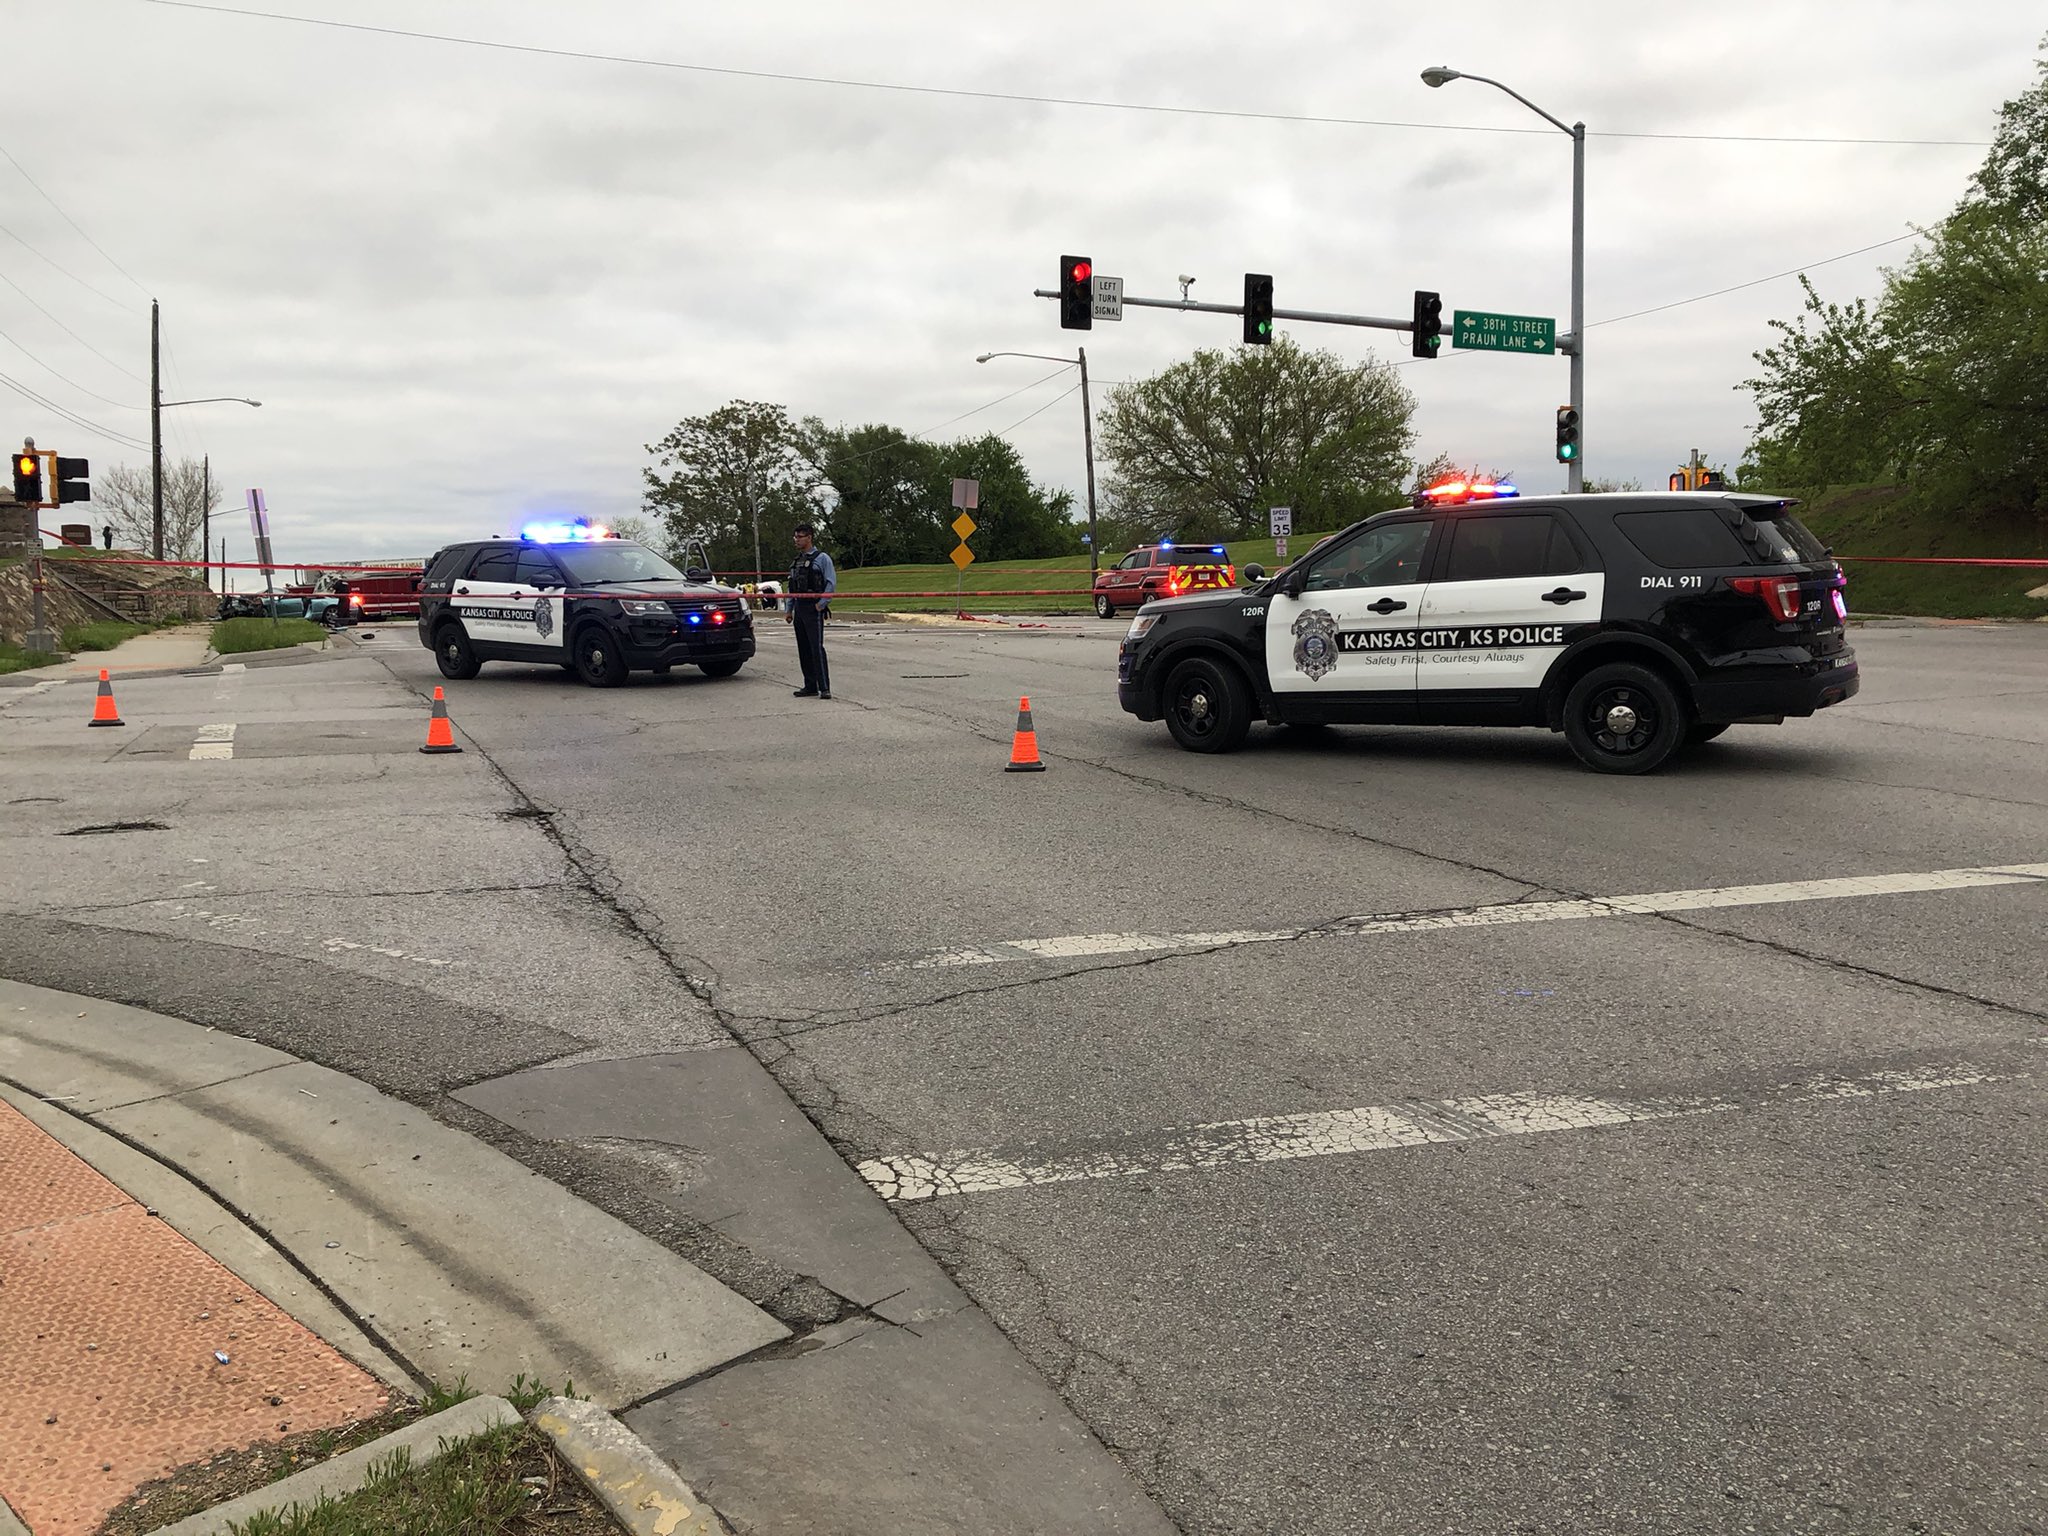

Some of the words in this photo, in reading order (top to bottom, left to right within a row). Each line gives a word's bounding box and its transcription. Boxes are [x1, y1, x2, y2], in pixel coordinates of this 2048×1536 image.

[1100, 281, 1116, 291] LEFT
[1098, 293, 1117, 303] TURN
[1095, 306, 1119, 316] SIGNAL
[1483, 318, 1506, 331] 38TH
[1513, 320, 1548, 334] STREET
[1462, 332, 1497, 346] PRAUN
[1503, 335, 1527, 348] LANE
[1273, 524, 1290, 536] 35
[1640, 576, 1674, 588] DIAL
[1680, 576, 1702, 588] 911
[461, 608, 486, 617] KANSAS
[503, 610, 511, 618] KS
[512, 611, 533, 620] POLICE
[1241, 607, 1264, 617] 120R
[1344, 632, 1417, 649] KANSAS
[1420, 630, 1465, 648] CITY,
[1470, 629, 1493, 645] KS
[1498, 626, 1564, 644] POLICE
[1365, 656, 1397, 667] Safety
[1432, 652, 1480, 665] Courtesy
[1484, 652, 1524, 663] Always
